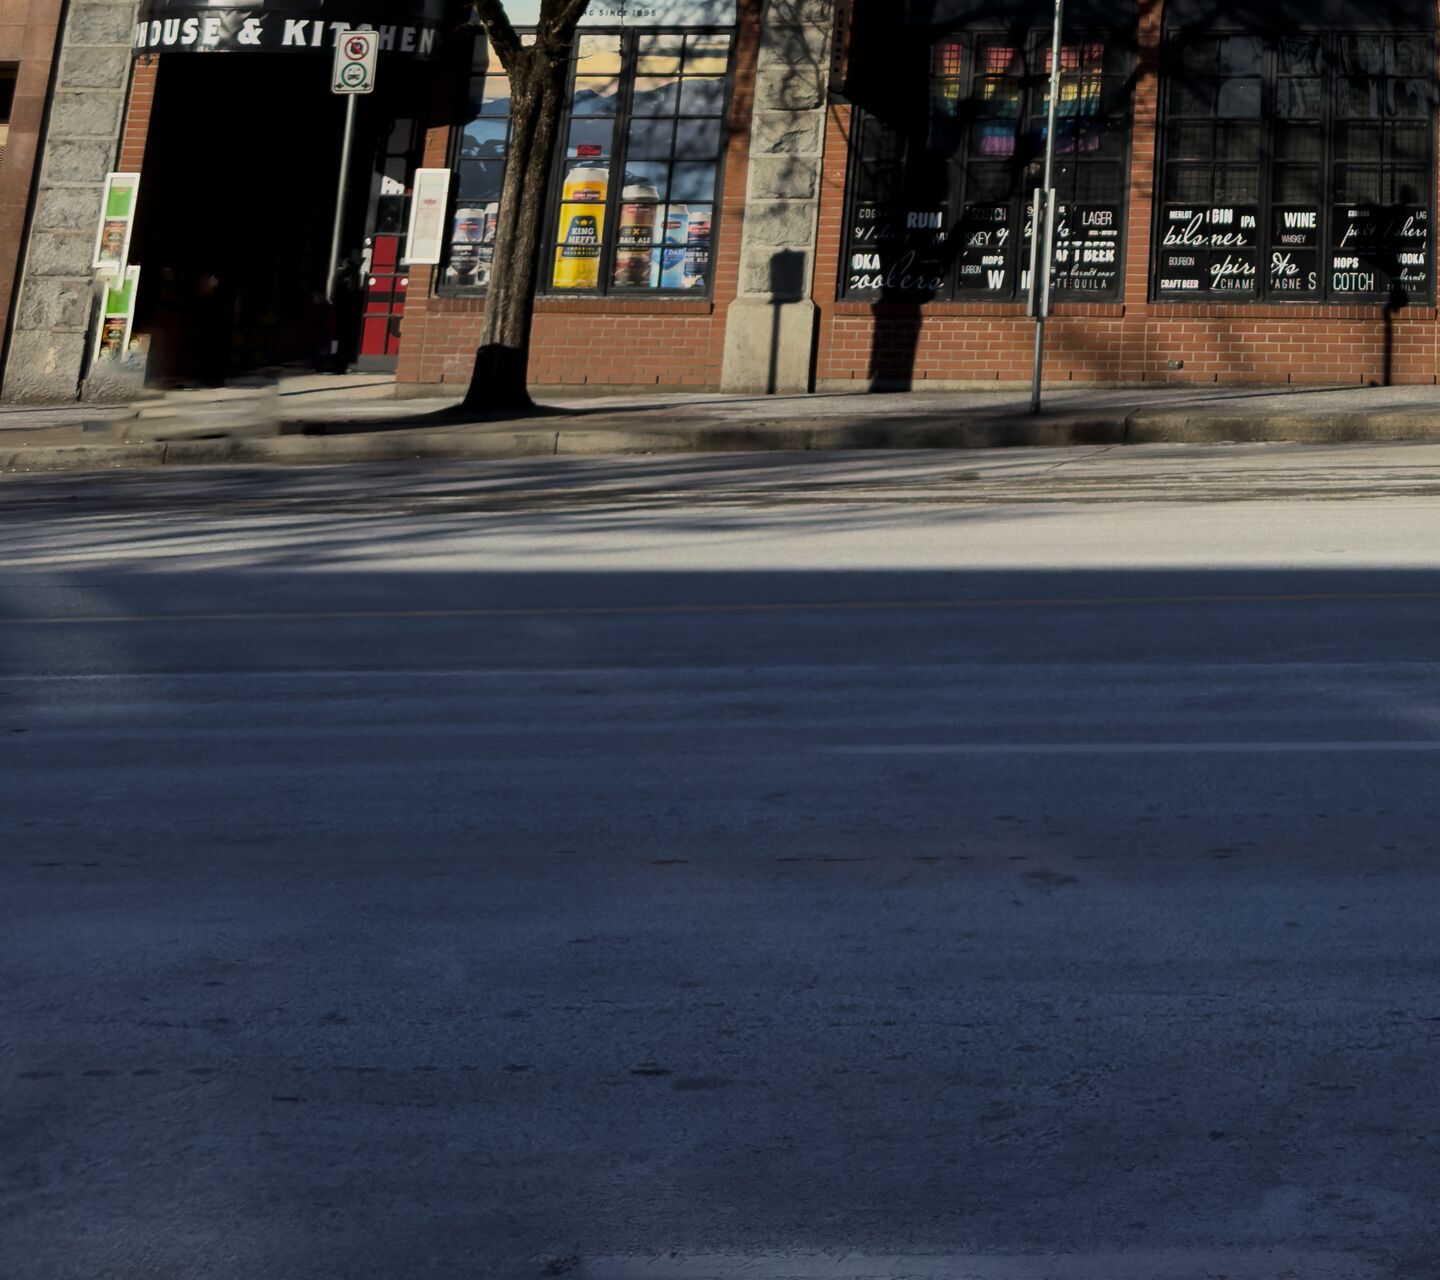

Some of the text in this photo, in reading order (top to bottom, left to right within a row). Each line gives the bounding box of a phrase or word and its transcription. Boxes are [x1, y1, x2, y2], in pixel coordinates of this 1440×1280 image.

[236, 17, 263, 45] &
[906, 211, 944, 230] RUM
[1082, 210, 1113, 226] LAGER
[1169, 208, 1256, 228] MERLOT GIN IPA
[1284, 212, 1317, 228] WINE
[571, 227, 595, 236] KING
[1281, 234, 1307, 244] WHISKEY
[982, 255, 1004, 266] HOPS
[1168, 256, 1195, 266] BOURBON
[1334, 252, 1425, 268] HOPS VODKA
[1161, 279, 1200, 289] CRAFT BEER
